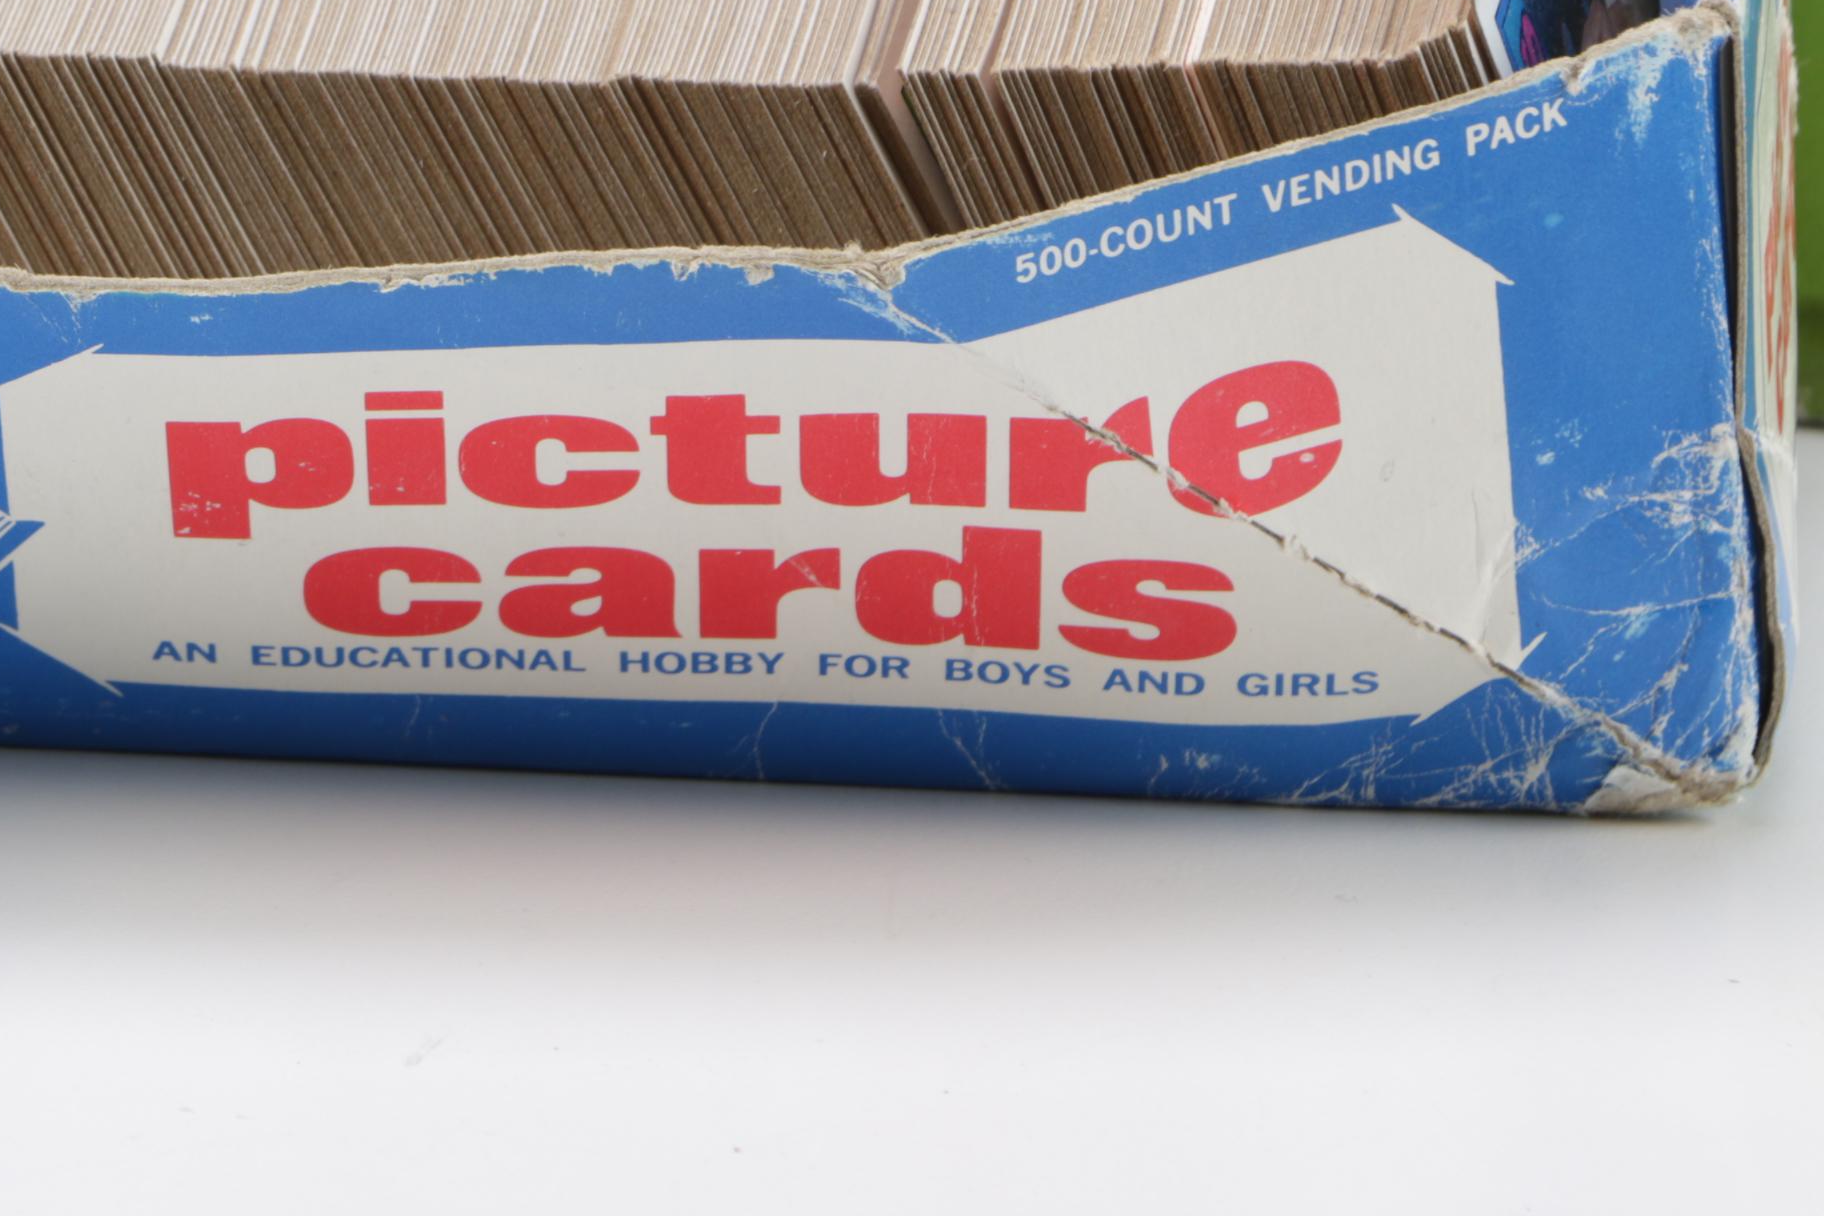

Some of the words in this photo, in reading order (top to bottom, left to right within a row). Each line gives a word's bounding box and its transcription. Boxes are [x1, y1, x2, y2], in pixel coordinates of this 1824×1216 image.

[1014, 192, 1238, 284] 500-COUNT
[1260, 138, 1442, 214] VENDING
[1464, 97, 1570, 157] PACK
[164, 360, 1343, 540] picture
[151, 640, 218, 664] AN
[249, 644, 588, 673] EDUCATIONAL
[618, 650, 785, 675] HOBBY
[817, 652, 912, 679] FOR
[944, 658, 1072, 689] BOYS
[1102, 668, 1206, 696] AND
[1236, 670, 1381, 698] GIRLS
[303, 525, 1238, 662] cards
